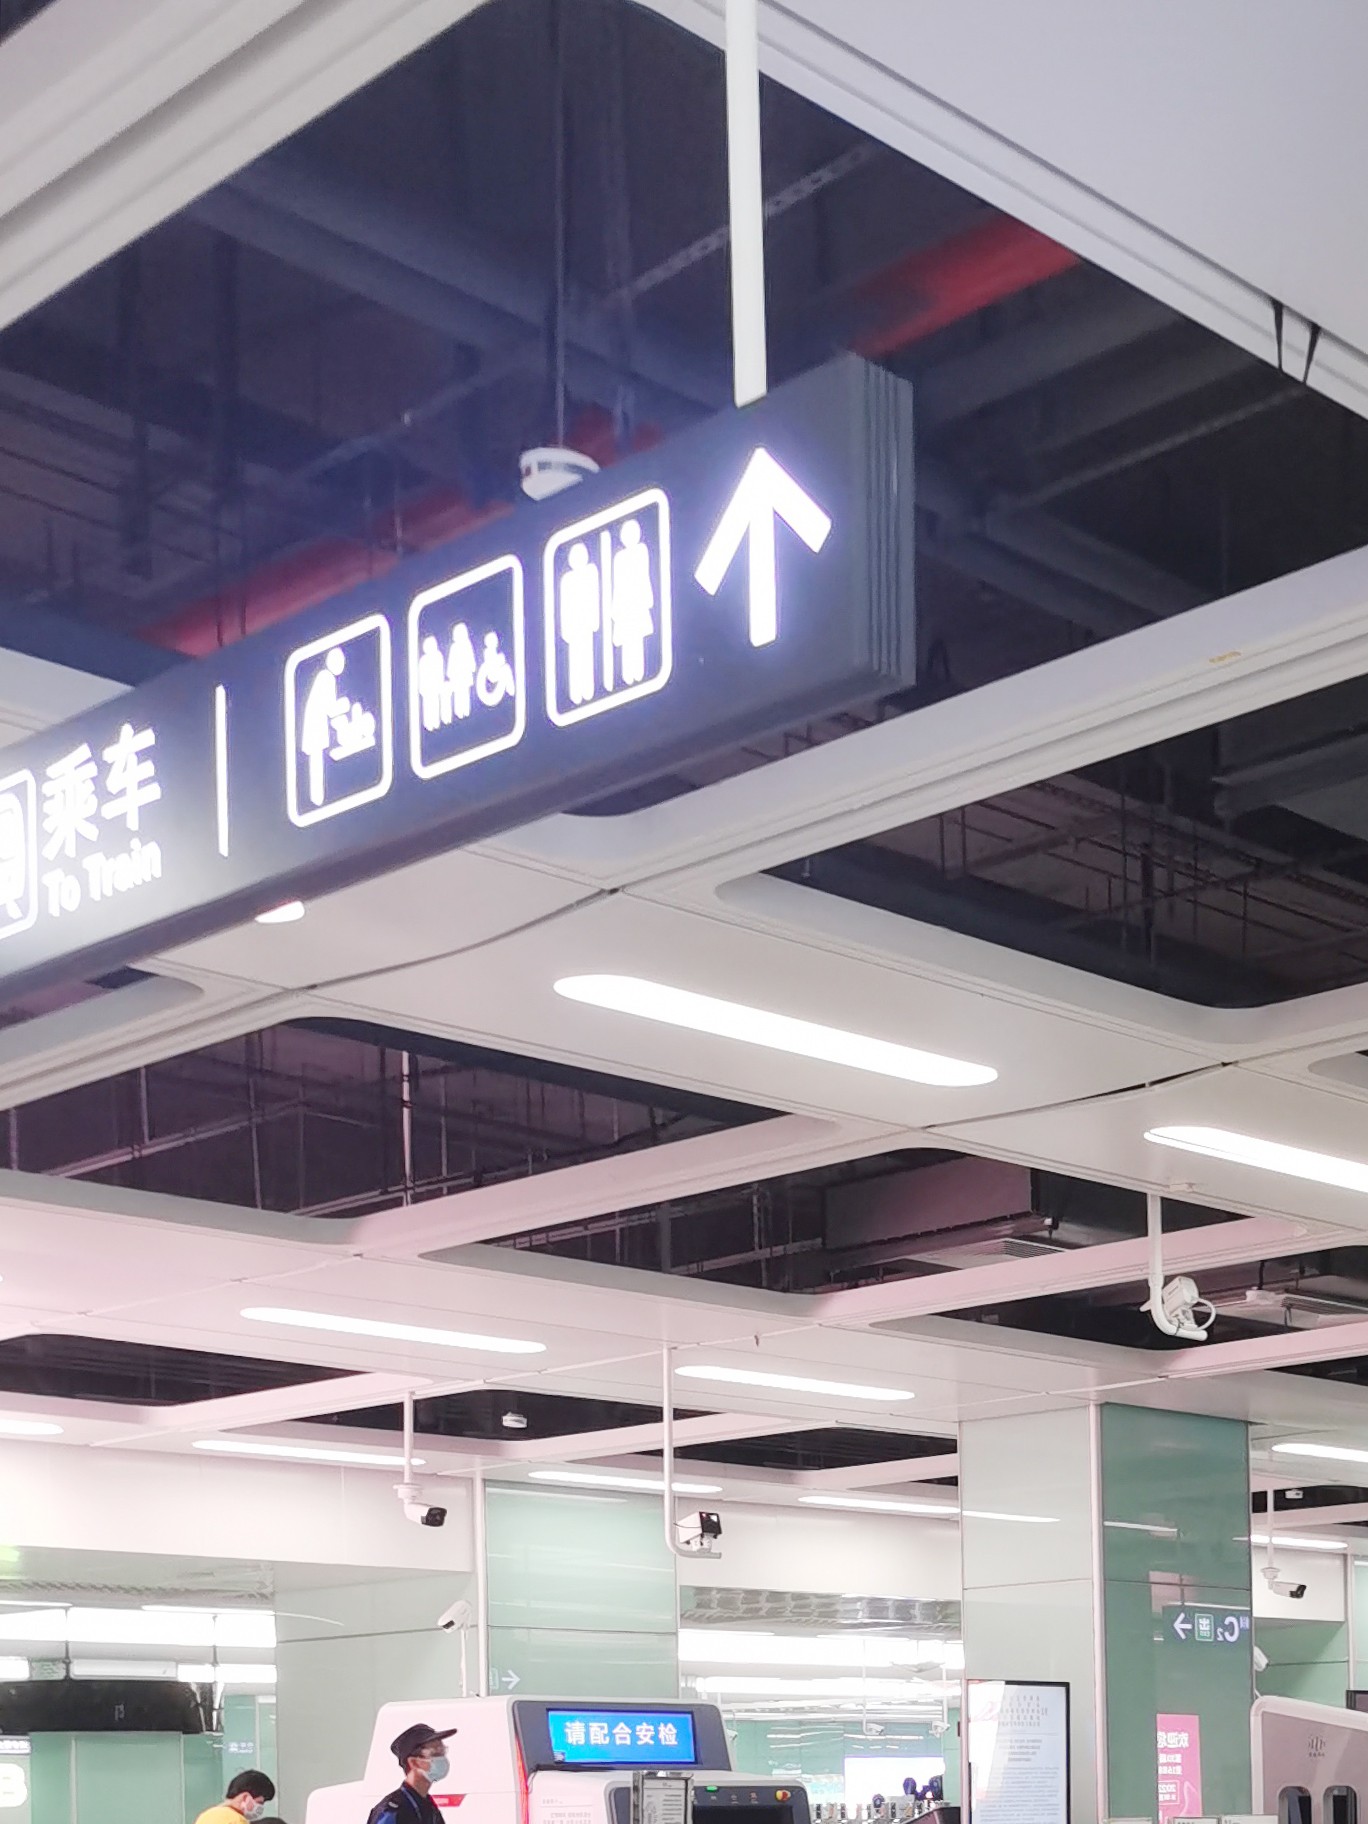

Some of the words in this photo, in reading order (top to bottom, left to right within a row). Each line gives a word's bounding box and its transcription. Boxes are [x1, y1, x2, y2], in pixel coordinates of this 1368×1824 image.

[41, 722, 162, 861] 乘车
[41, 868, 81, 917] To
[82, 837, 162, 901] Train
[564, 1720, 678, 1746] 请配合安检
